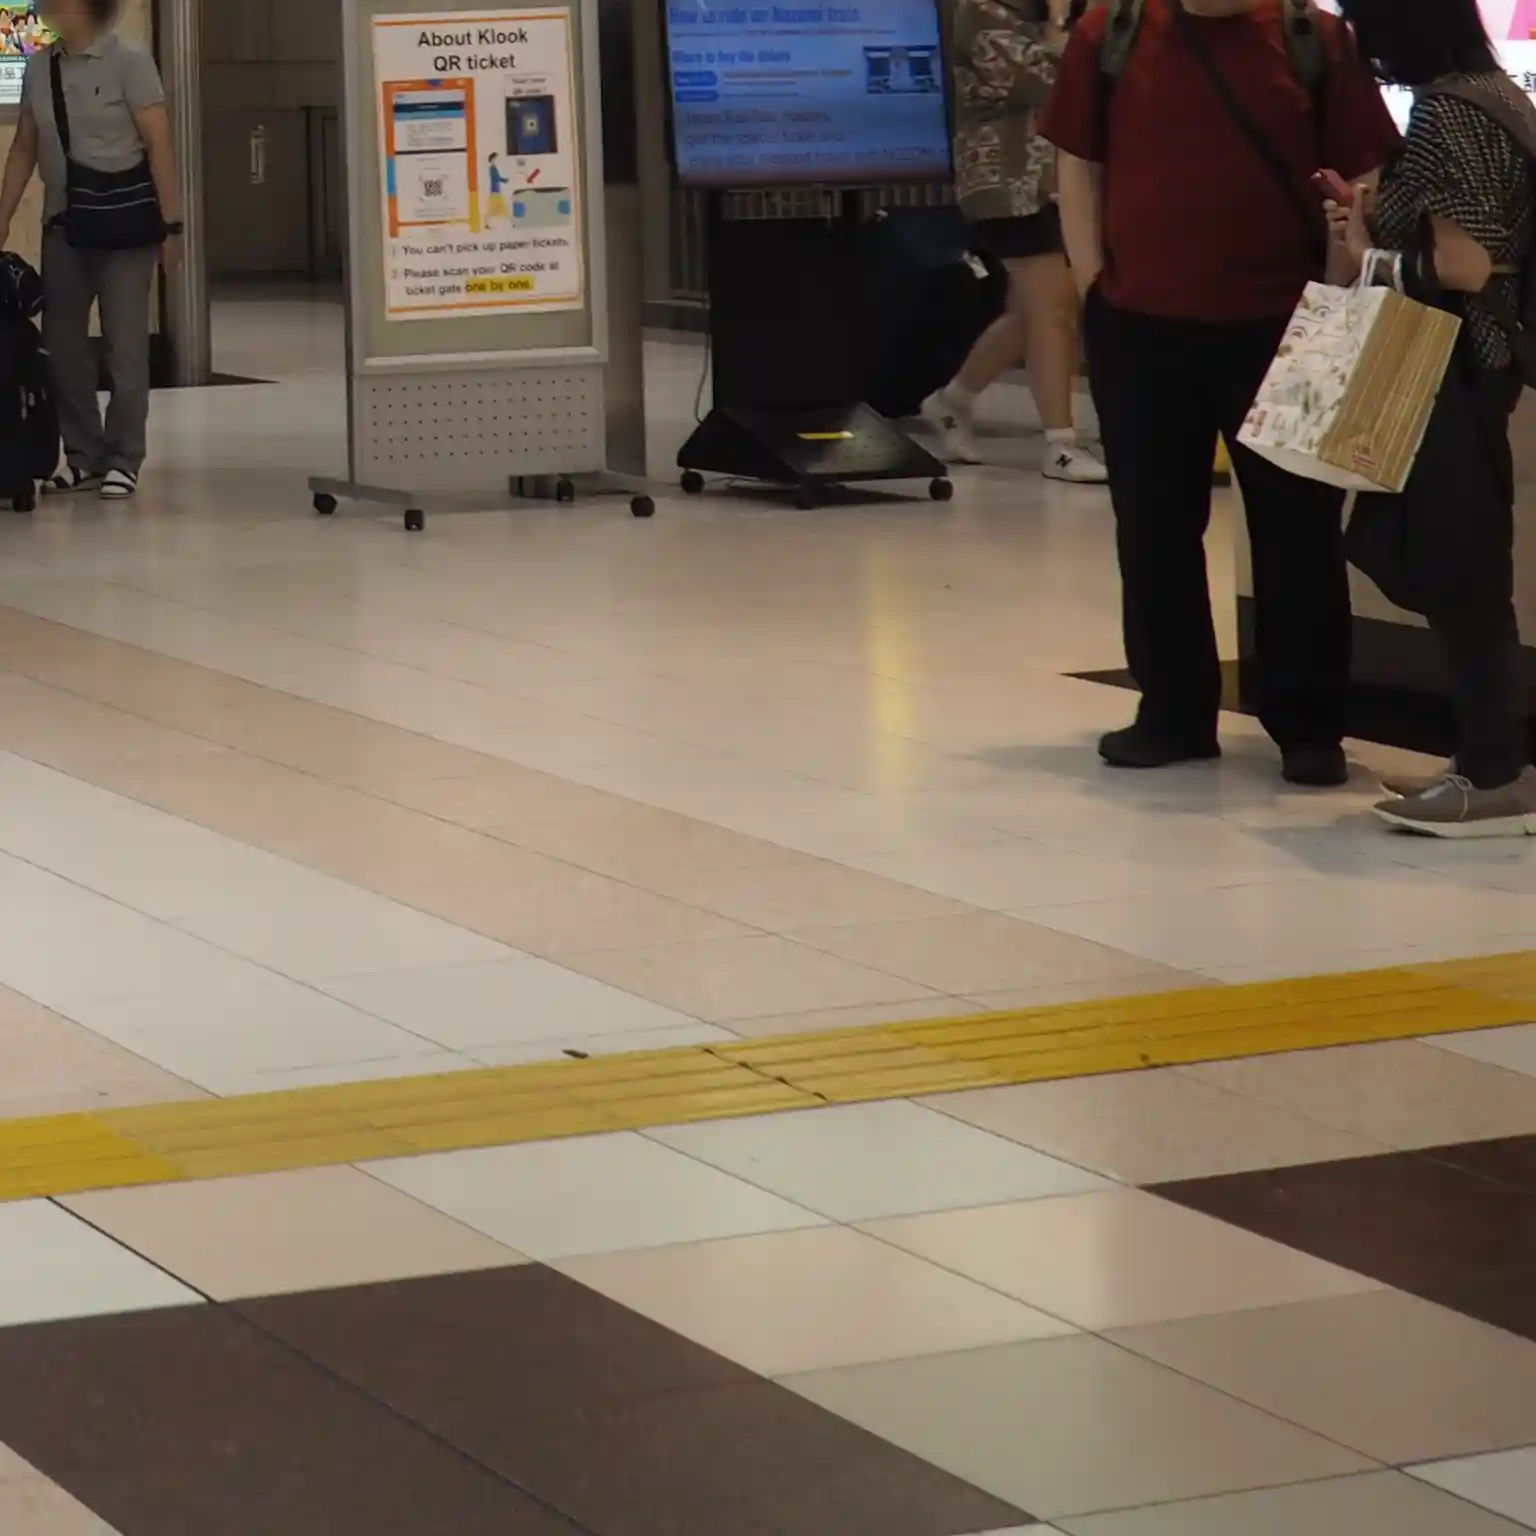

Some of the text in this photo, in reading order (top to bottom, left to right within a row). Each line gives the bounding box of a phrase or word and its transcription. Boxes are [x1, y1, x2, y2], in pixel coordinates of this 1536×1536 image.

[417, 28, 529, 49] About Klook
[433, 53, 516, 73] QR ticket
[402, 246, 423, 256] You
[426, 242, 454, 255] can't
[456, 242, 479, 254] pick
[483, 242, 497, 252] up
[499, 240, 529, 251] paper
[403, 267, 440, 280] Please
[442, 267, 469, 278] scan
[473, 266, 496, 277] your
[500, 262, 517, 274] QR
[520, 262, 546, 273] code
[405, 284, 436, 296] ticket
[438, 283, 462, 296] gate
[465, 282, 487, 293] one
[490, 280, 504, 292] by
